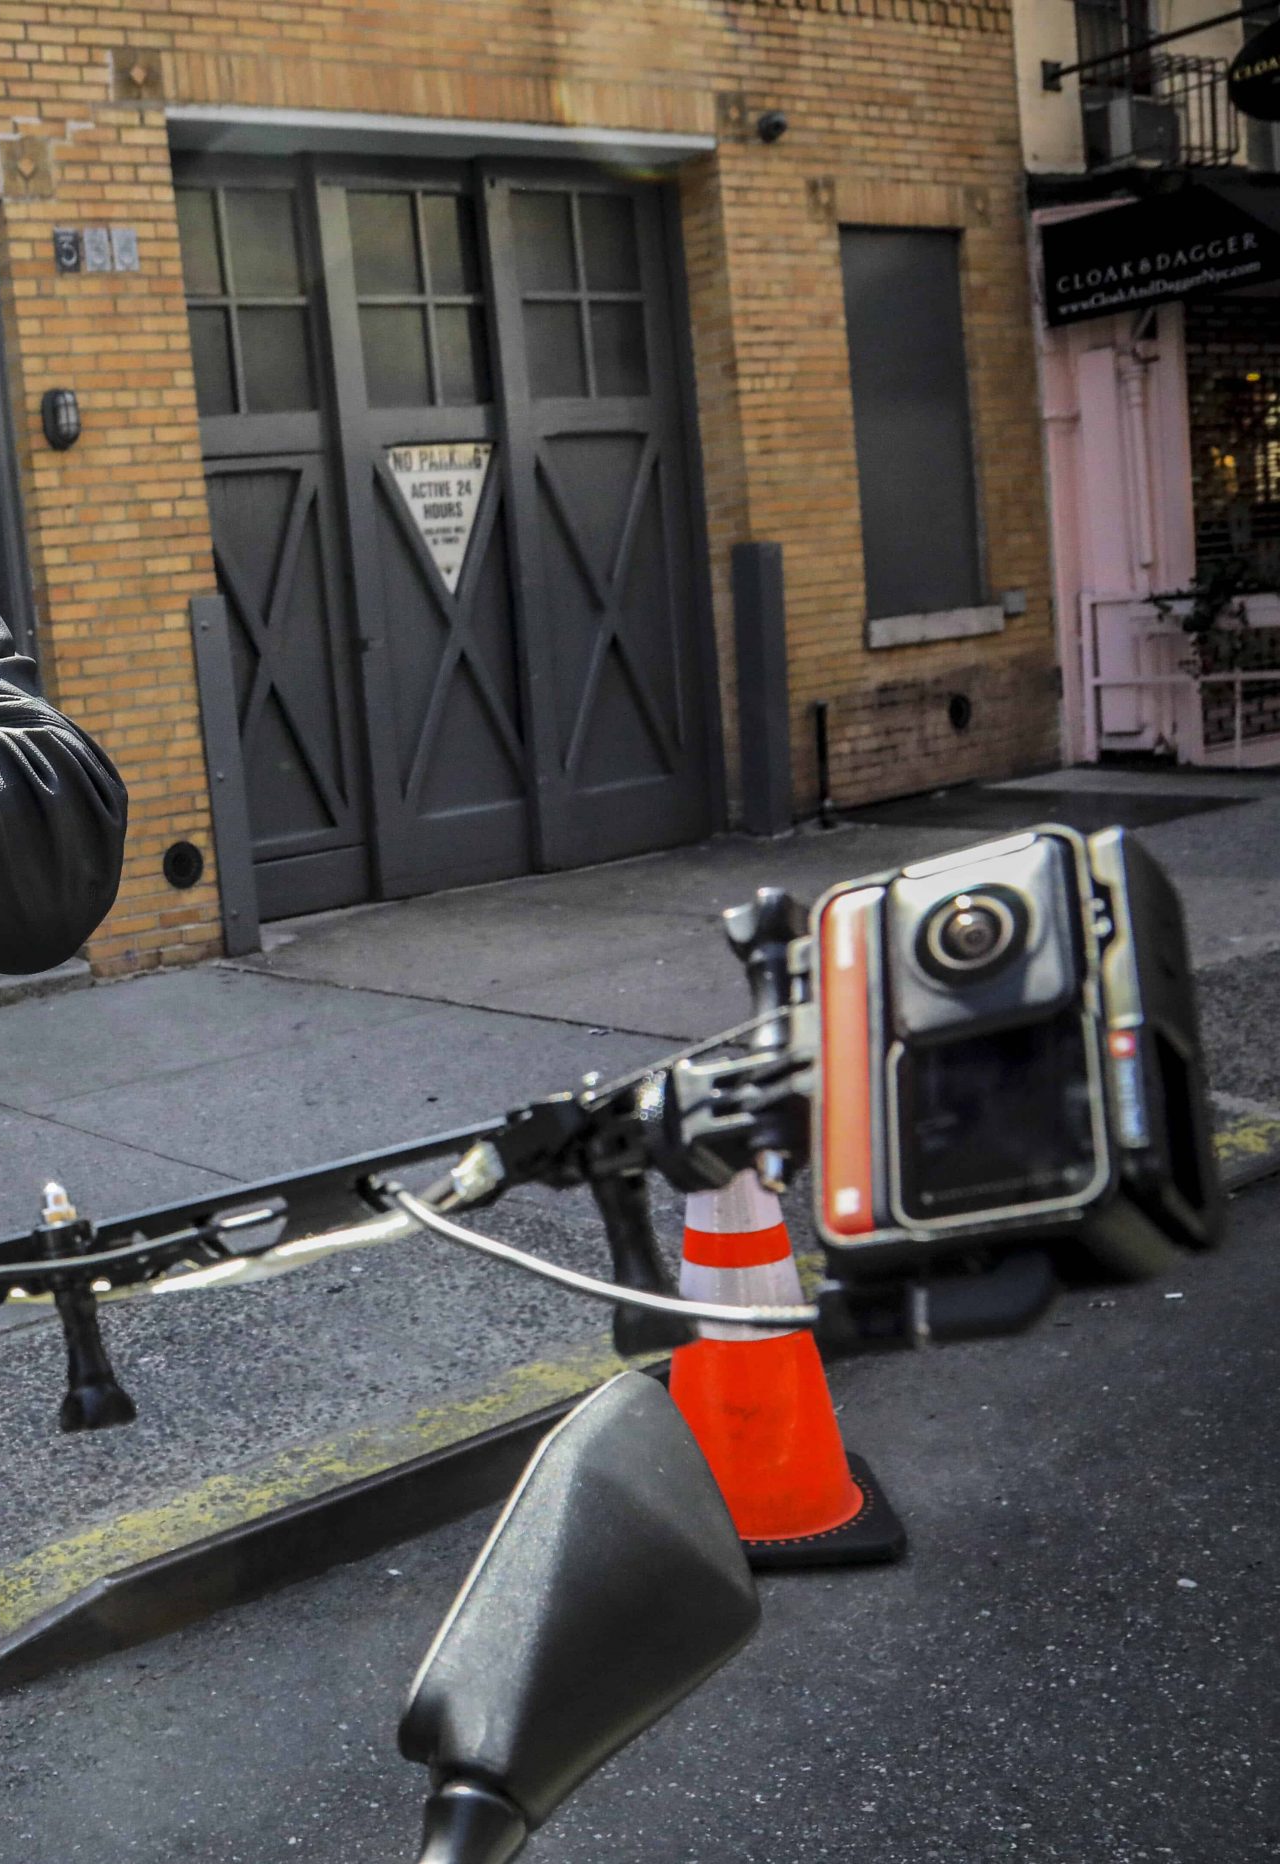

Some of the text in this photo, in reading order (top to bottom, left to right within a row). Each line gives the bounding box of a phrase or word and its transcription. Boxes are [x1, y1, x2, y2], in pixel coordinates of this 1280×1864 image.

[1233, 55, 1280, 81] CLOA
[392, 450, 412, 472] NO
[411, 479, 472, 499] ACTIVE 24
[423, 502, 463, 520] HOURS
